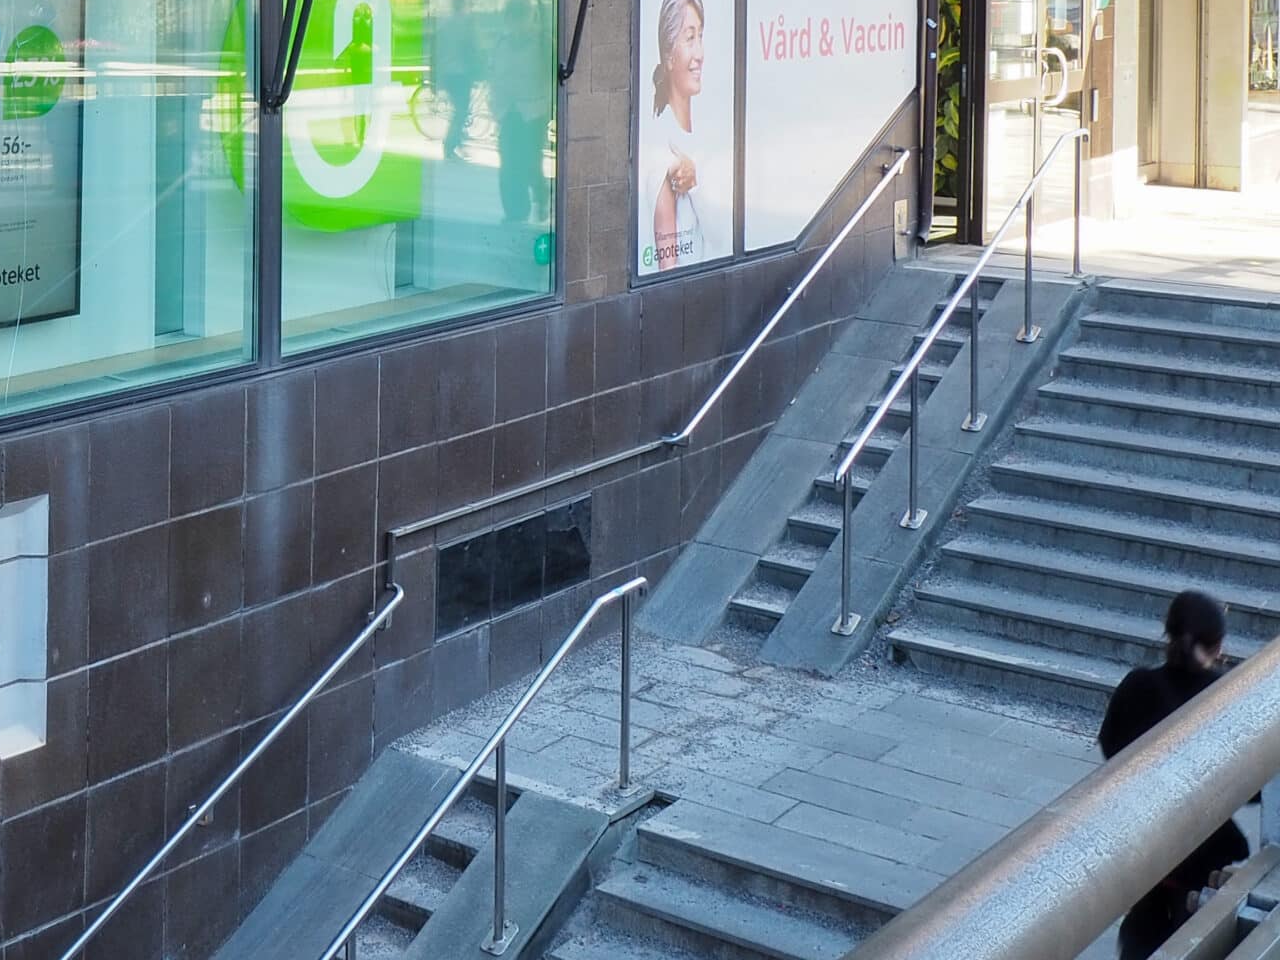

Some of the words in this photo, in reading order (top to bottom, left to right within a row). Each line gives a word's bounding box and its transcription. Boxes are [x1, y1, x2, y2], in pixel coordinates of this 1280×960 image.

[759, 14, 812, 61] Vård
[818, 17, 835, 57] &
[841, 12, 906, 55] Vaccin
[1, 136, 32, 155] 56:-
[653, 240, 694, 264] apoteket
